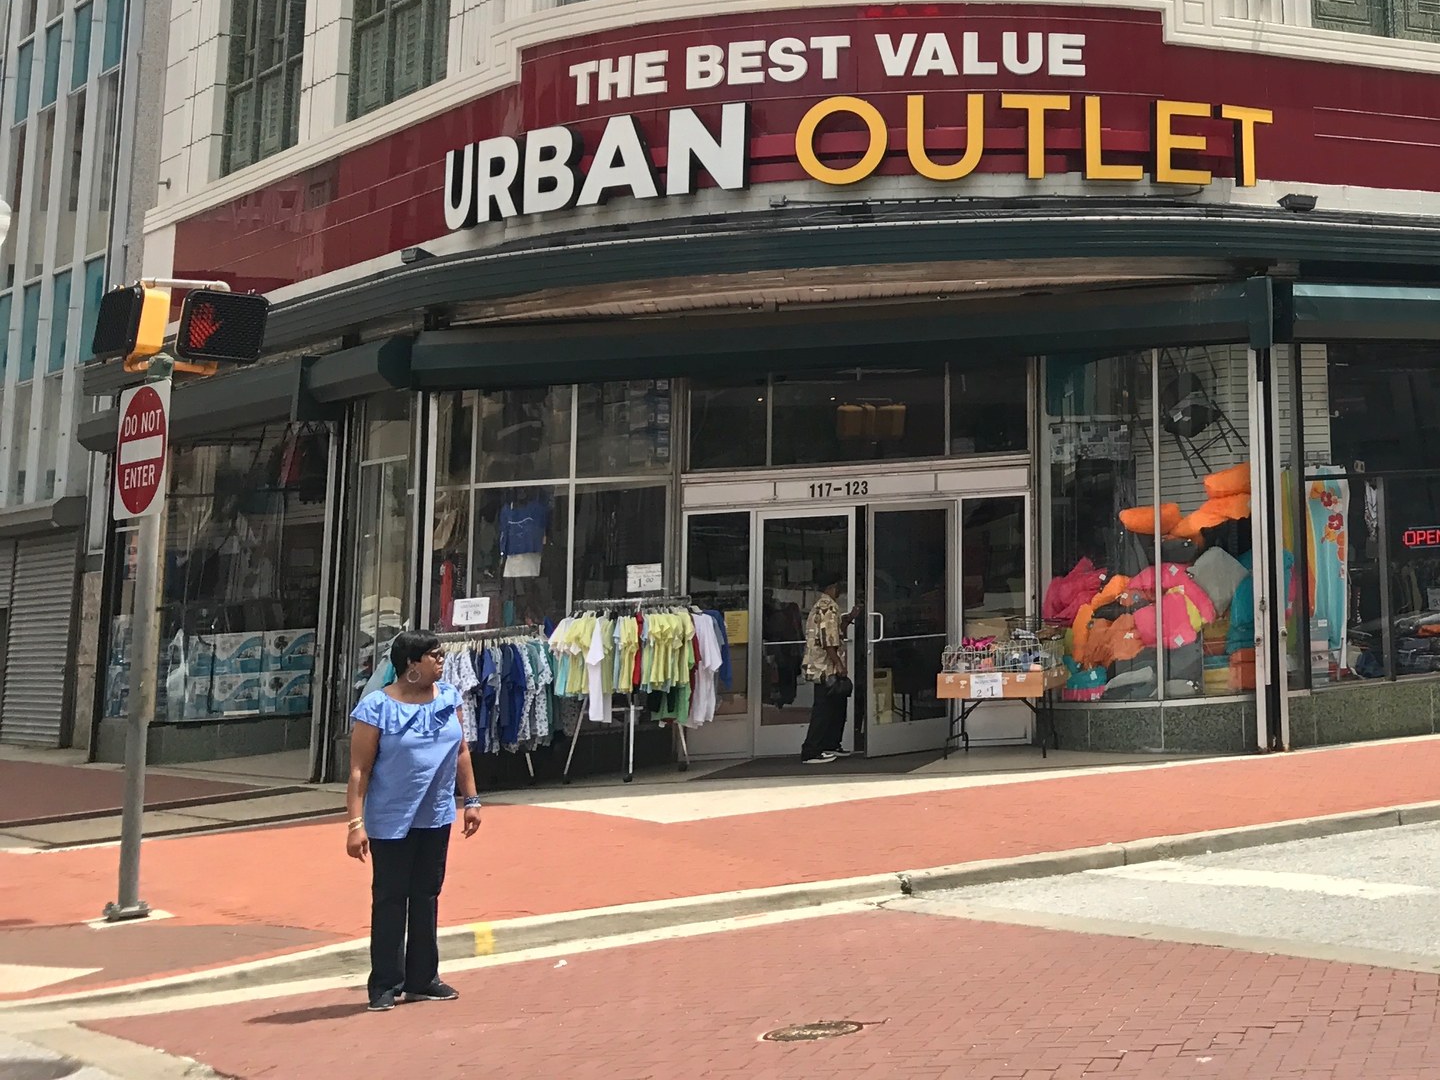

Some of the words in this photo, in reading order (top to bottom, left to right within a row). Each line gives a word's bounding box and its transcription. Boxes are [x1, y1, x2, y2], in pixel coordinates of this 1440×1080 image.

[568, 49, 669, 106] THE
[684, 35, 851, 90] BEST
[875, 31, 1087, 78] VALUE
[444, 102, 751, 231] URBAN
[794, 92, 1274, 188] OUTLET
[124, 414, 138, 437] DO
[141, 409, 162, 433] NOT
[124, 464, 155, 490] ENTER
[810, 481, 868, 497] 117-123
